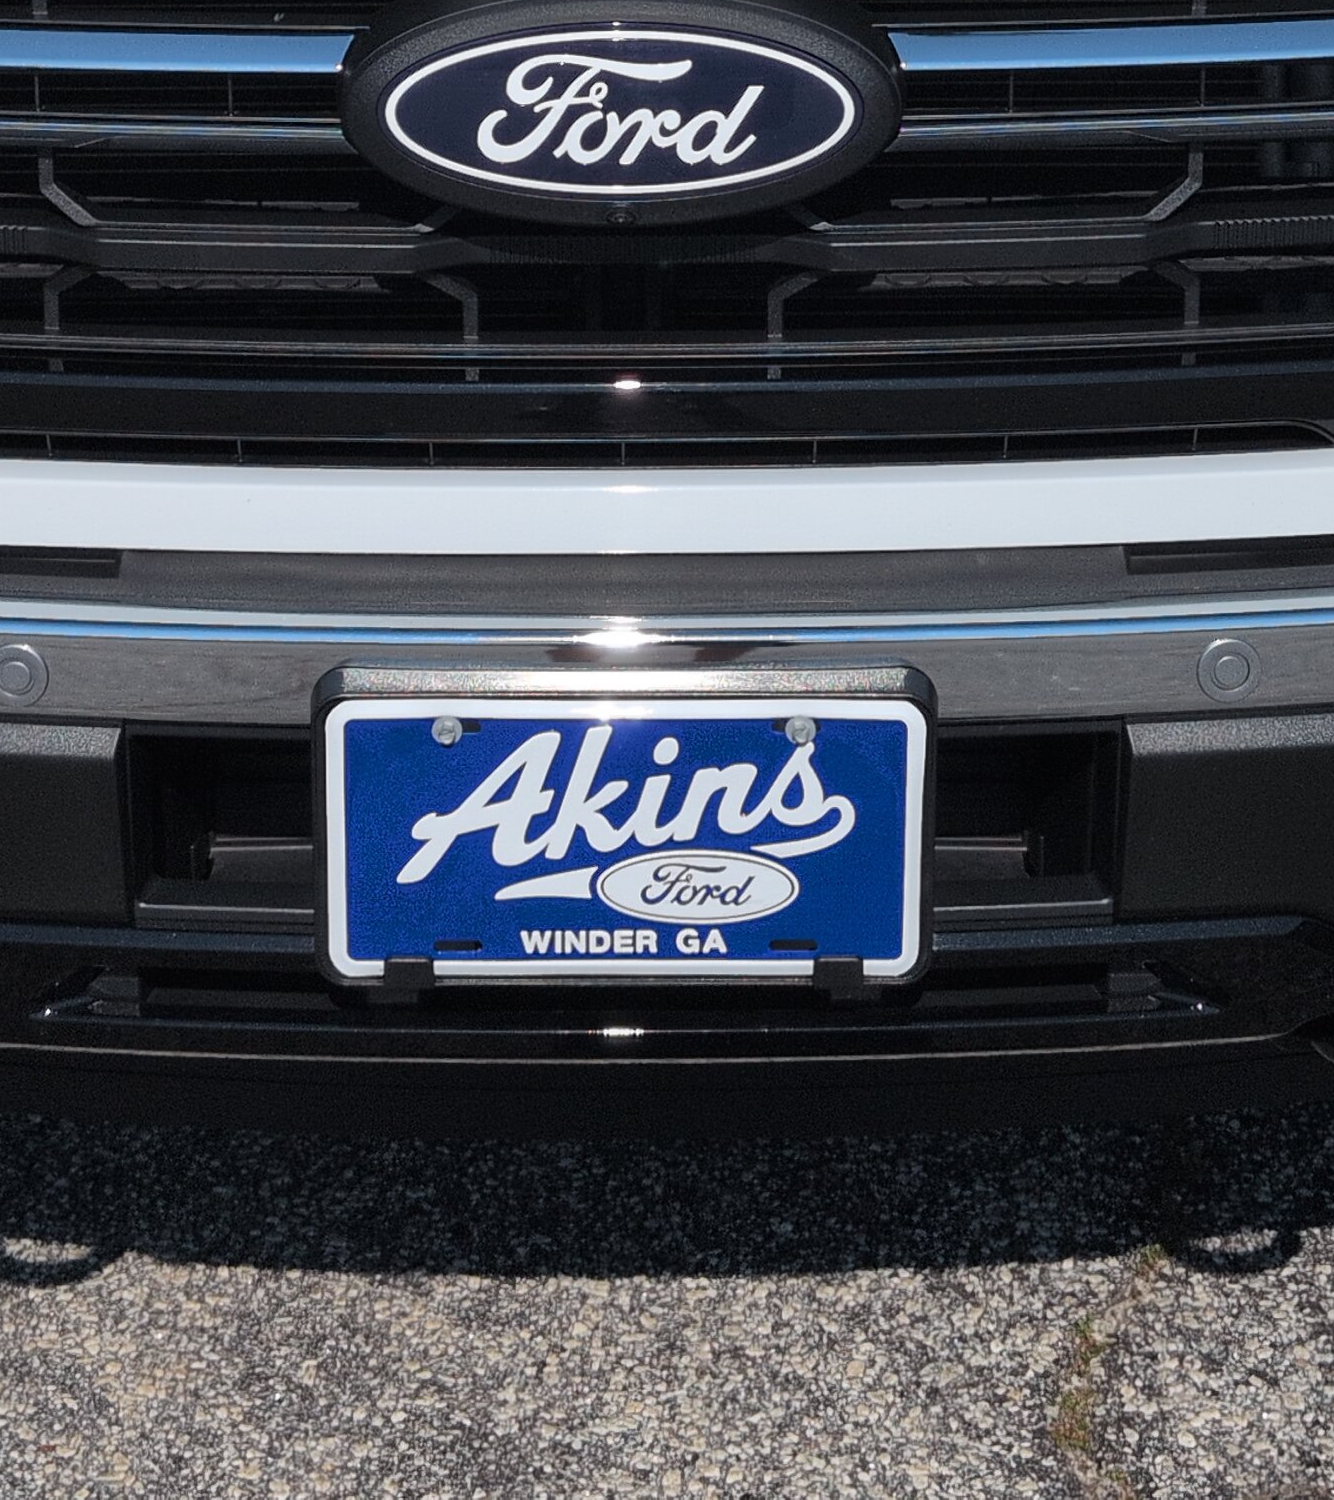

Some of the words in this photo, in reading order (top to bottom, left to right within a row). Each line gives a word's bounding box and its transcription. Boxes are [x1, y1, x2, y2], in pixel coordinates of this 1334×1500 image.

[476, 53, 764, 165] Ford
[397, 725, 856, 884] Akins
[640, 862, 754, 907] Ford
[519, 928, 658, 954] WINDER
[676, 928, 728, 955] GA
